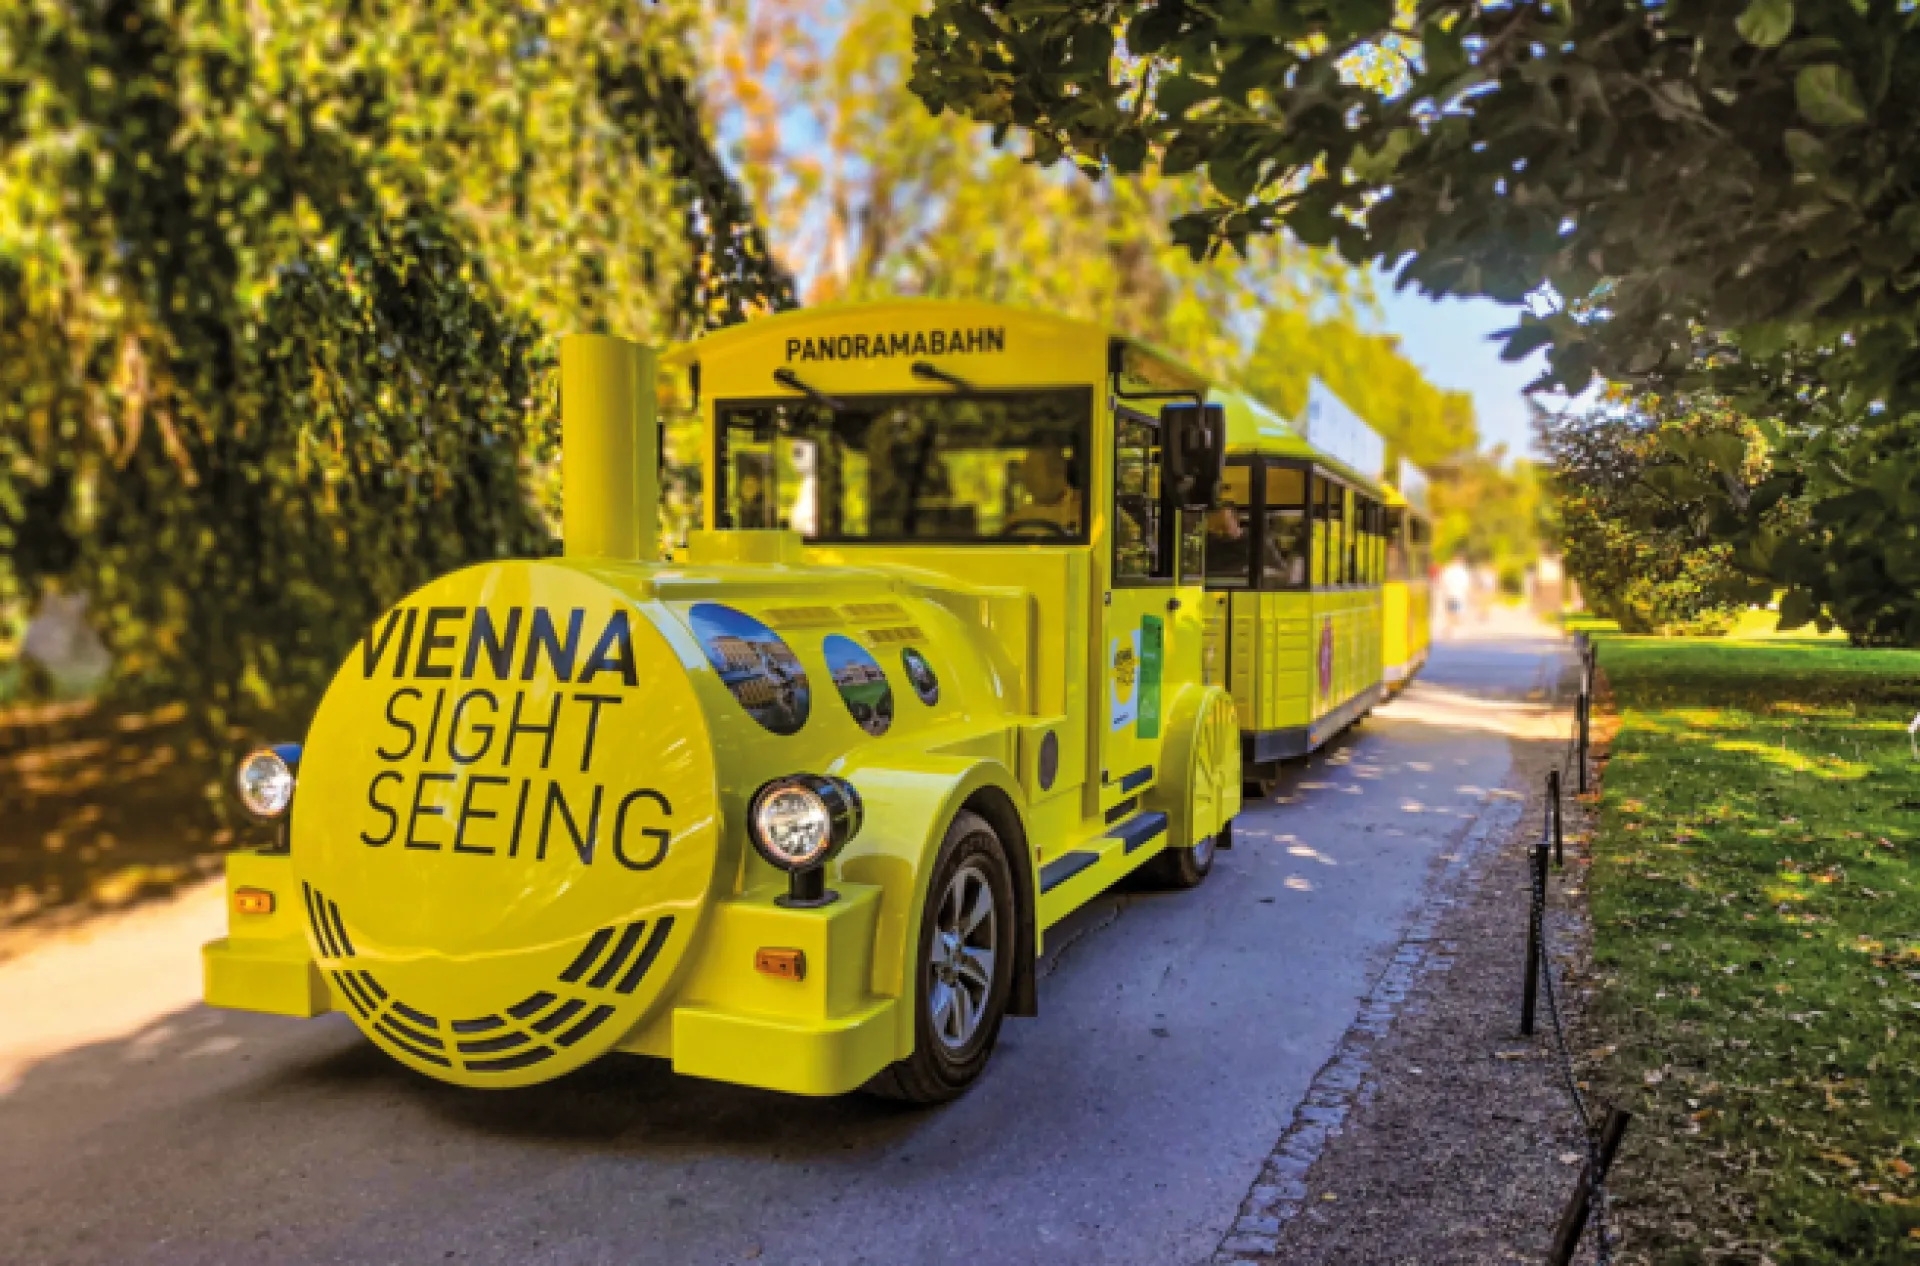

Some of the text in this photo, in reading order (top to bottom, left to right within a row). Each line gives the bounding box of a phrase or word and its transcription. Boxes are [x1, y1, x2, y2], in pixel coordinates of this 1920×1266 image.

[785, 326, 1006, 362] PANORAMABAHN
[361, 606, 640, 686] VIENNA
[375, 687, 622, 772] SIGHT
[359, 770, 673, 871] SEEING
